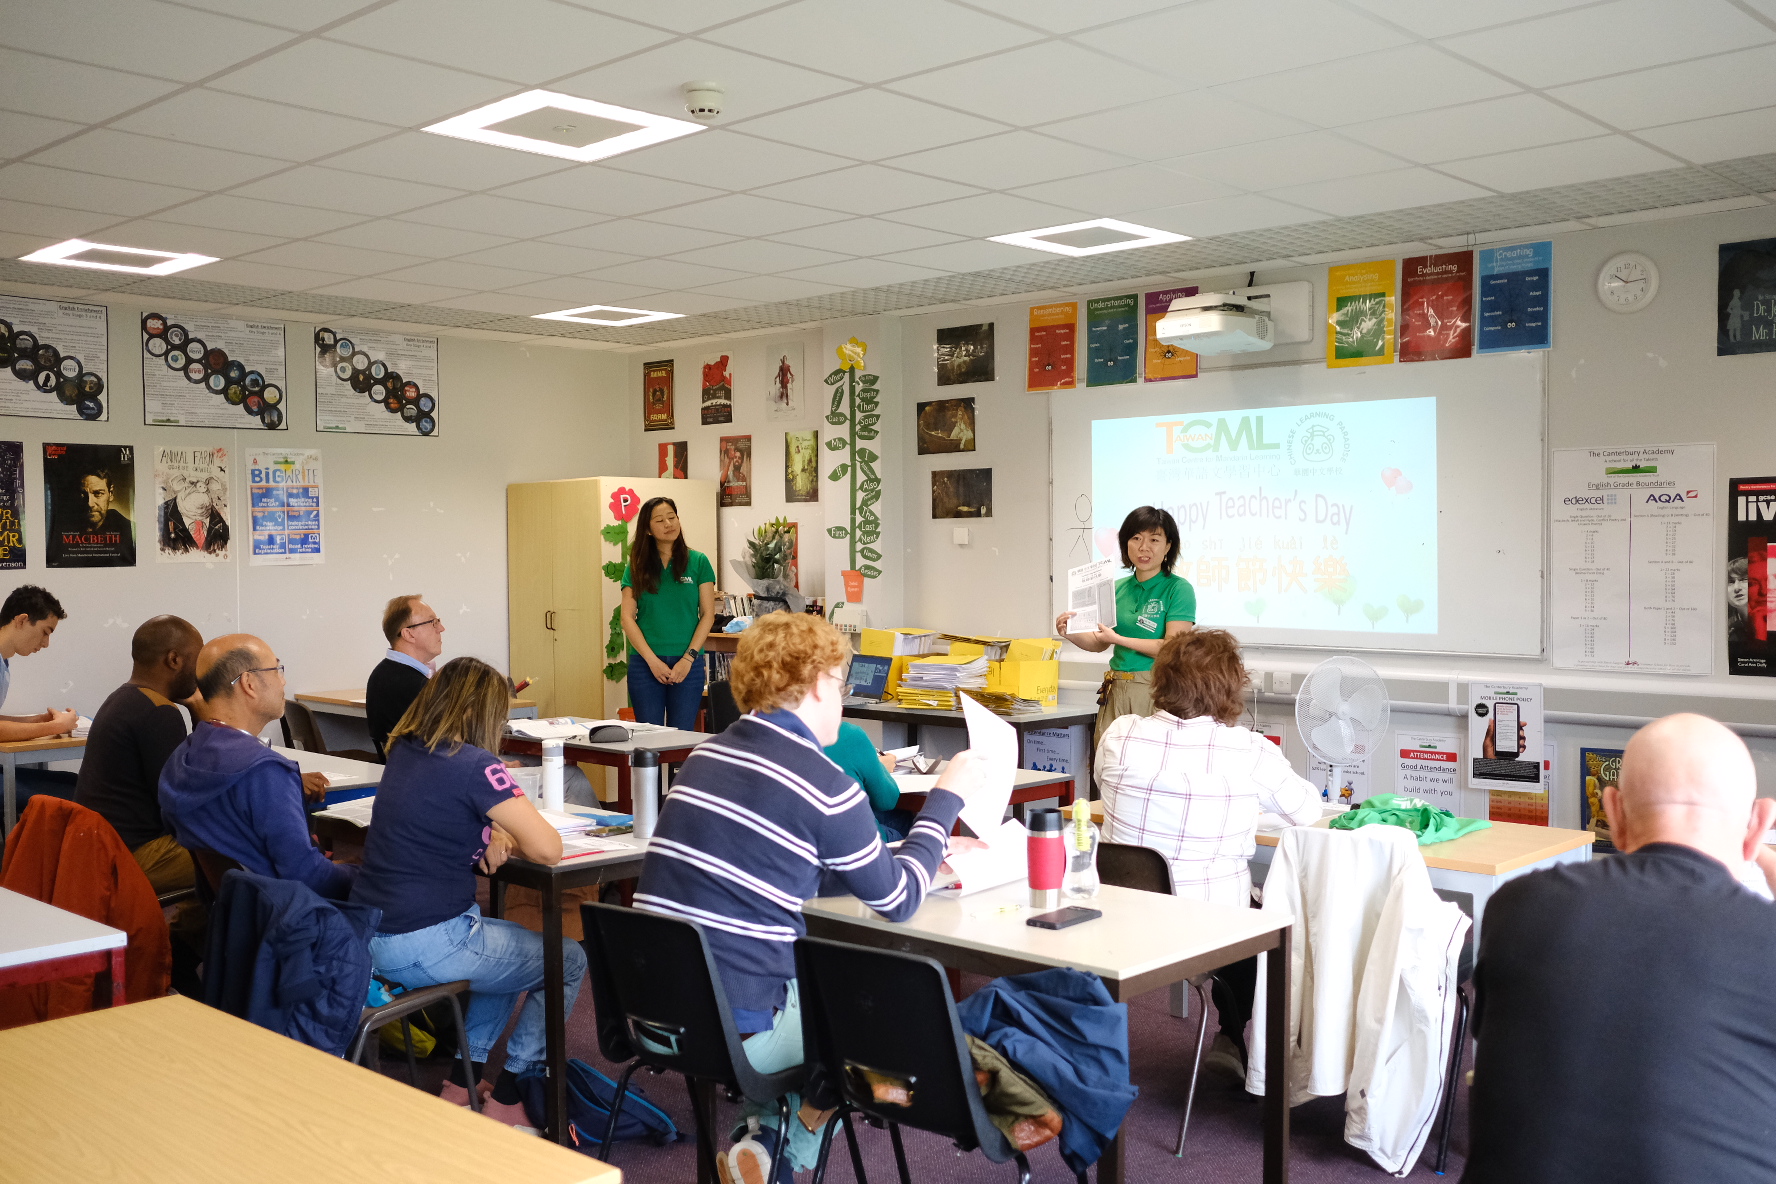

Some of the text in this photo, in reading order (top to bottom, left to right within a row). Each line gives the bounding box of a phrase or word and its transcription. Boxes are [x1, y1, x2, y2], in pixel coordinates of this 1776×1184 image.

[1497, 248, 1534, 258] Creating
[1418, 264, 1458, 274] Evaluating
[1345, 273, 1378, 282] Analysing
[1090, 298, 1134, 310] Understanding
[1754, 301, 1768, 317] Dr.
[1034, 306, 1072, 316] Remembering
[1752, 325, 1768, 340] Mr.
[827, 372, 844, 384] When
[860, 390, 876, 399] Despite
[860, 402, 876, 411] Then
[860, 416, 878, 426] Soon
[1296, 411, 1336, 427] LEARNING
[1156, 416, 1280, 454] TCML
[832, 438, 843, 450] My
[1286, 428, 1297, 466] CHINESE
[1336, 420, 1350, 464] PARADISE
[160, 450, 214, 466] ANIMAL FARM
[1215, 454, 1248, 462] Mandarin
[1249, 452, 1280, 461] Learning
[1602, 450, 1640, 458] Canterbury
[863, 480, 878, 491] Also
[1564, 494, 1605, 506] edexcel
[1646, 493, 1684, 504] AQA
[620, 494, 632, 514] P
[862, 505, 875, 520] The
[1315, 494, 1353, 534] Day
[862, 522, 876, 531] Last
[831, 528, 846, 538] First
[63, 534, 120, 544] MACBETH
[862, 534, 878, 544] Next
[860, 566, 878, 576] Besides
[1410, 752, 1446, 760] ATTENDANCE
[1420, 764, 1456, 772] Attendance
[1410, 774, 1428, 782] habit
[1404, 786, 1420, 794] build
